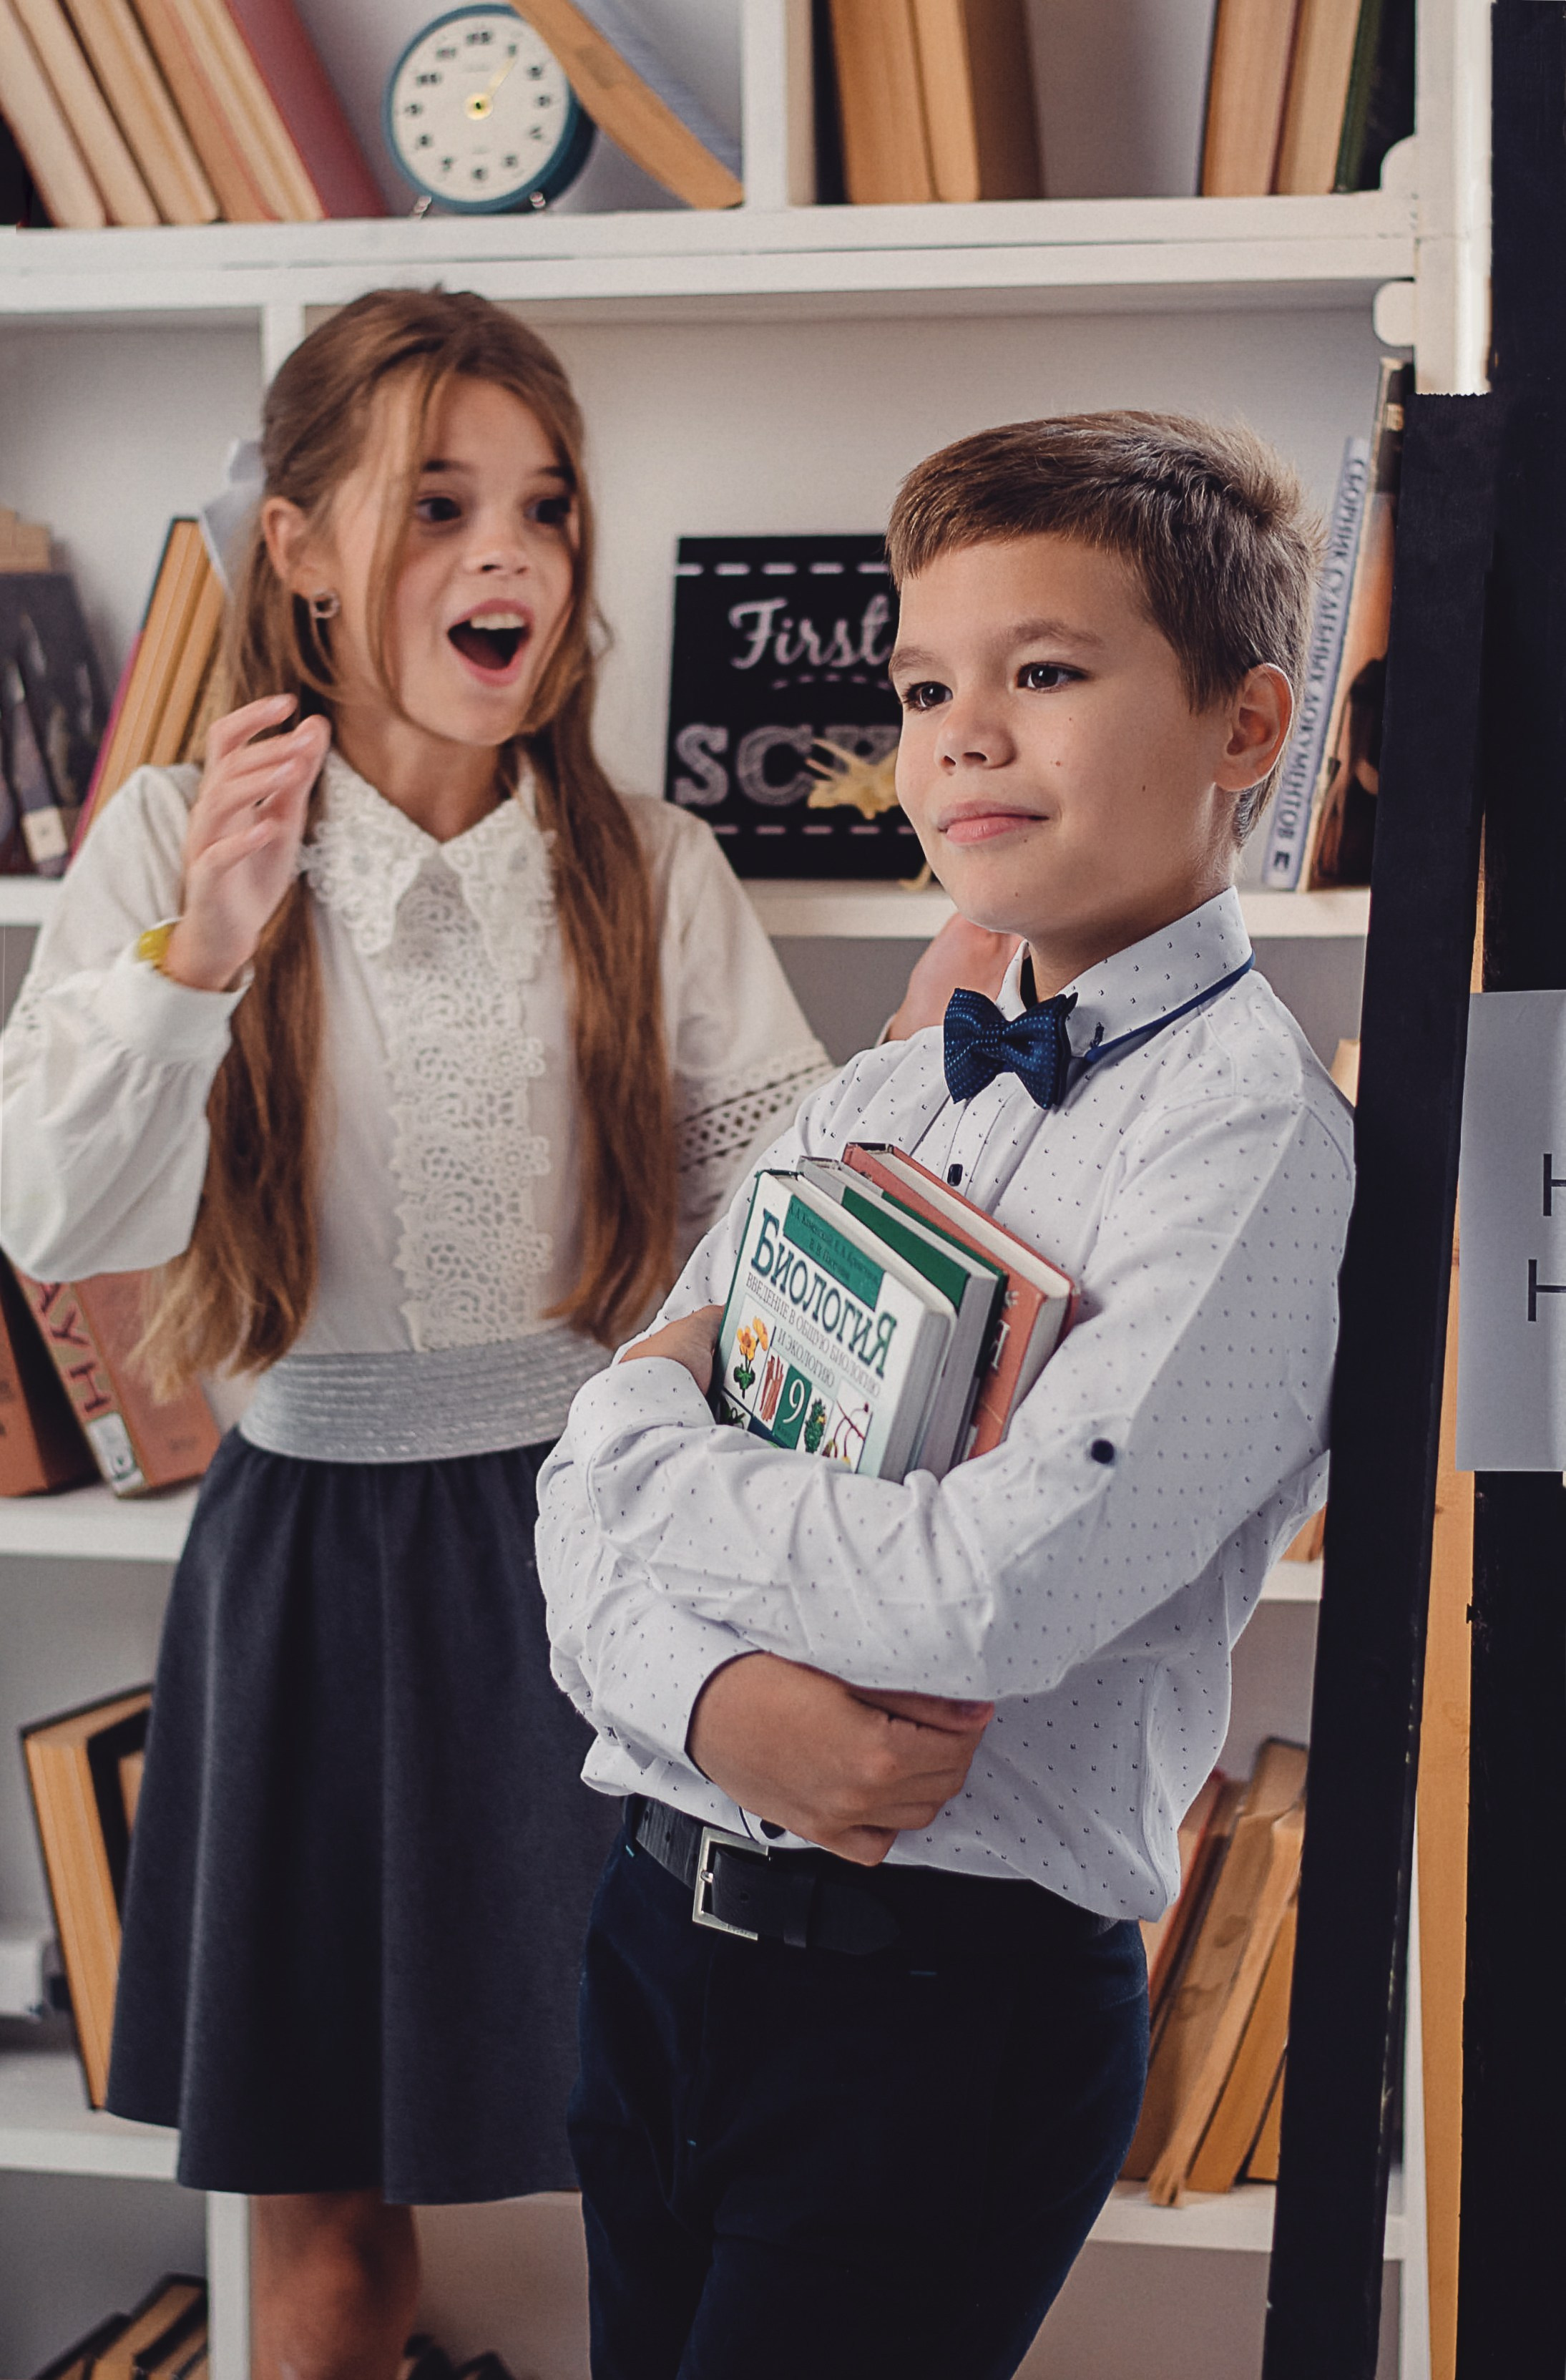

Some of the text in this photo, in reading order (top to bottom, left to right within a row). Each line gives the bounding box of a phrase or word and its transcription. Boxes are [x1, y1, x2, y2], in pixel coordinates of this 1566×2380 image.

[729, 594, 893, 669] First
[751, 1208, 898, 1379] БИОЛОГИЯ
[746, 1272, 881, 1397] ВВЕДЕНИЕ В ОБЩУЮ БИОЛОГИЮ
[778, 1328, 835, 1388] И ЭКОЛОГИЮ
[783, 1379, 805, 1423] 9
